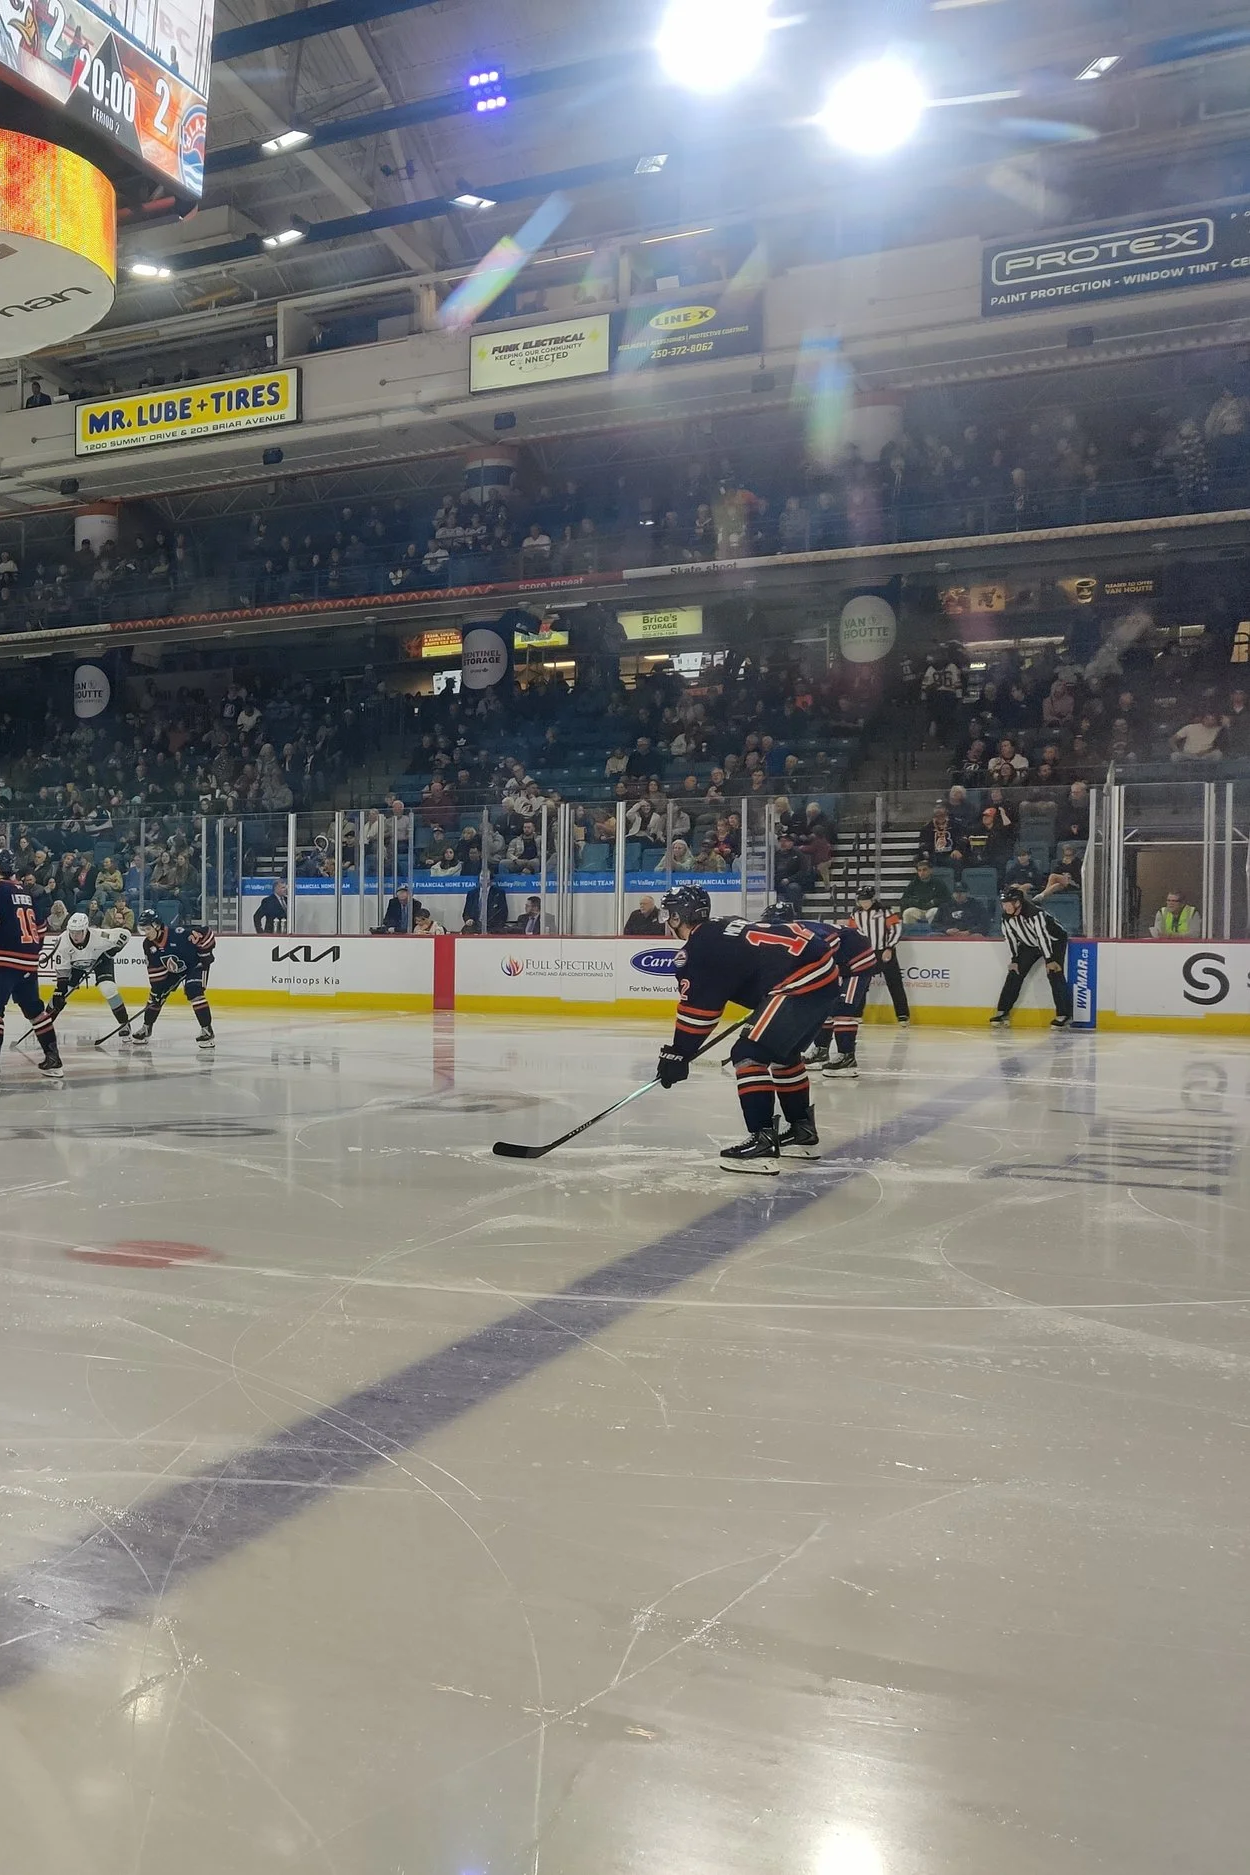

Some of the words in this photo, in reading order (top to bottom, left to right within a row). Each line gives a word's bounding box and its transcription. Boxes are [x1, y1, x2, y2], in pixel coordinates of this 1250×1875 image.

[45, 0, 66, 61] 2
[76, 48, 136, 124] 20:00
[152, 78, 170, 136] 2
[91, 105, 114, 131] PERIOD
[115, 124, 120, 135] 2
[1005, 228, 1198, 276] PROTEX
[990, 291, 1028, 306] PAINT
[1030, 278, 1111, 300] PROTECTION
[1123, 267, 1185, 286] WINDOW
[1188, 261, 1219, 275] TINT
[1230, 255, 1250, 268] CE
[654, 308, 710, 327] LINE-X
[491, 342, 521, 355] FUNK
[522, 332, 586, 350] ELECTRICAL
[494, 351, 524, 361] KEEPING
[524, 349, 540, 357] OUR
[540, 342, 583, 354] COMMUNITY
[650, 341, 714, 359] 250-372-8062
[88, 409, 133, 435] MR.
[137, 397, 193, 427] LUBE
[196, 398, 208, 413] +
[210, 381, 281, 415] TIRES
[84, 441, 108, 452] 1200
[110, 435, 147, 448] SUMMIT
[149, 430, 178, 441] DRIVE
[180, 428, 188, 437] &
[190, 425, 209, 435] 203
[212, 420, 243, 432] BRIAR
[245, 413, 286, 427] AVENUE
[1105, 587, 1124, 595] VAN
[1125, 586, 1154, 594] HOUTTE
[642, 613, 678, 624] Brice's
[642, 622, 678, 631] STORAGE
[844, 617, 866, 629] VAN
[843, 626, 890, 640] HOUTTE
[462, 656, 501, 666] STORAGE
[75, 689, 104, 699] OUTTE
[638, 879, 655, 887] Valley
[16, 907, 40, 944] 16
[271, 945, 341, 963] KIA
[640, 954, 675, 968] Carr
[525, 958, 552, 970] FULL
[553, 958, 614, 971] SPECTRUM
[271, 975, 320, 986] Kamloops
[324, 976, 340, 985] Kia
[1076, 948, 1089, 1010] WINMAR.ca
[652, 985, 673, 993] World
